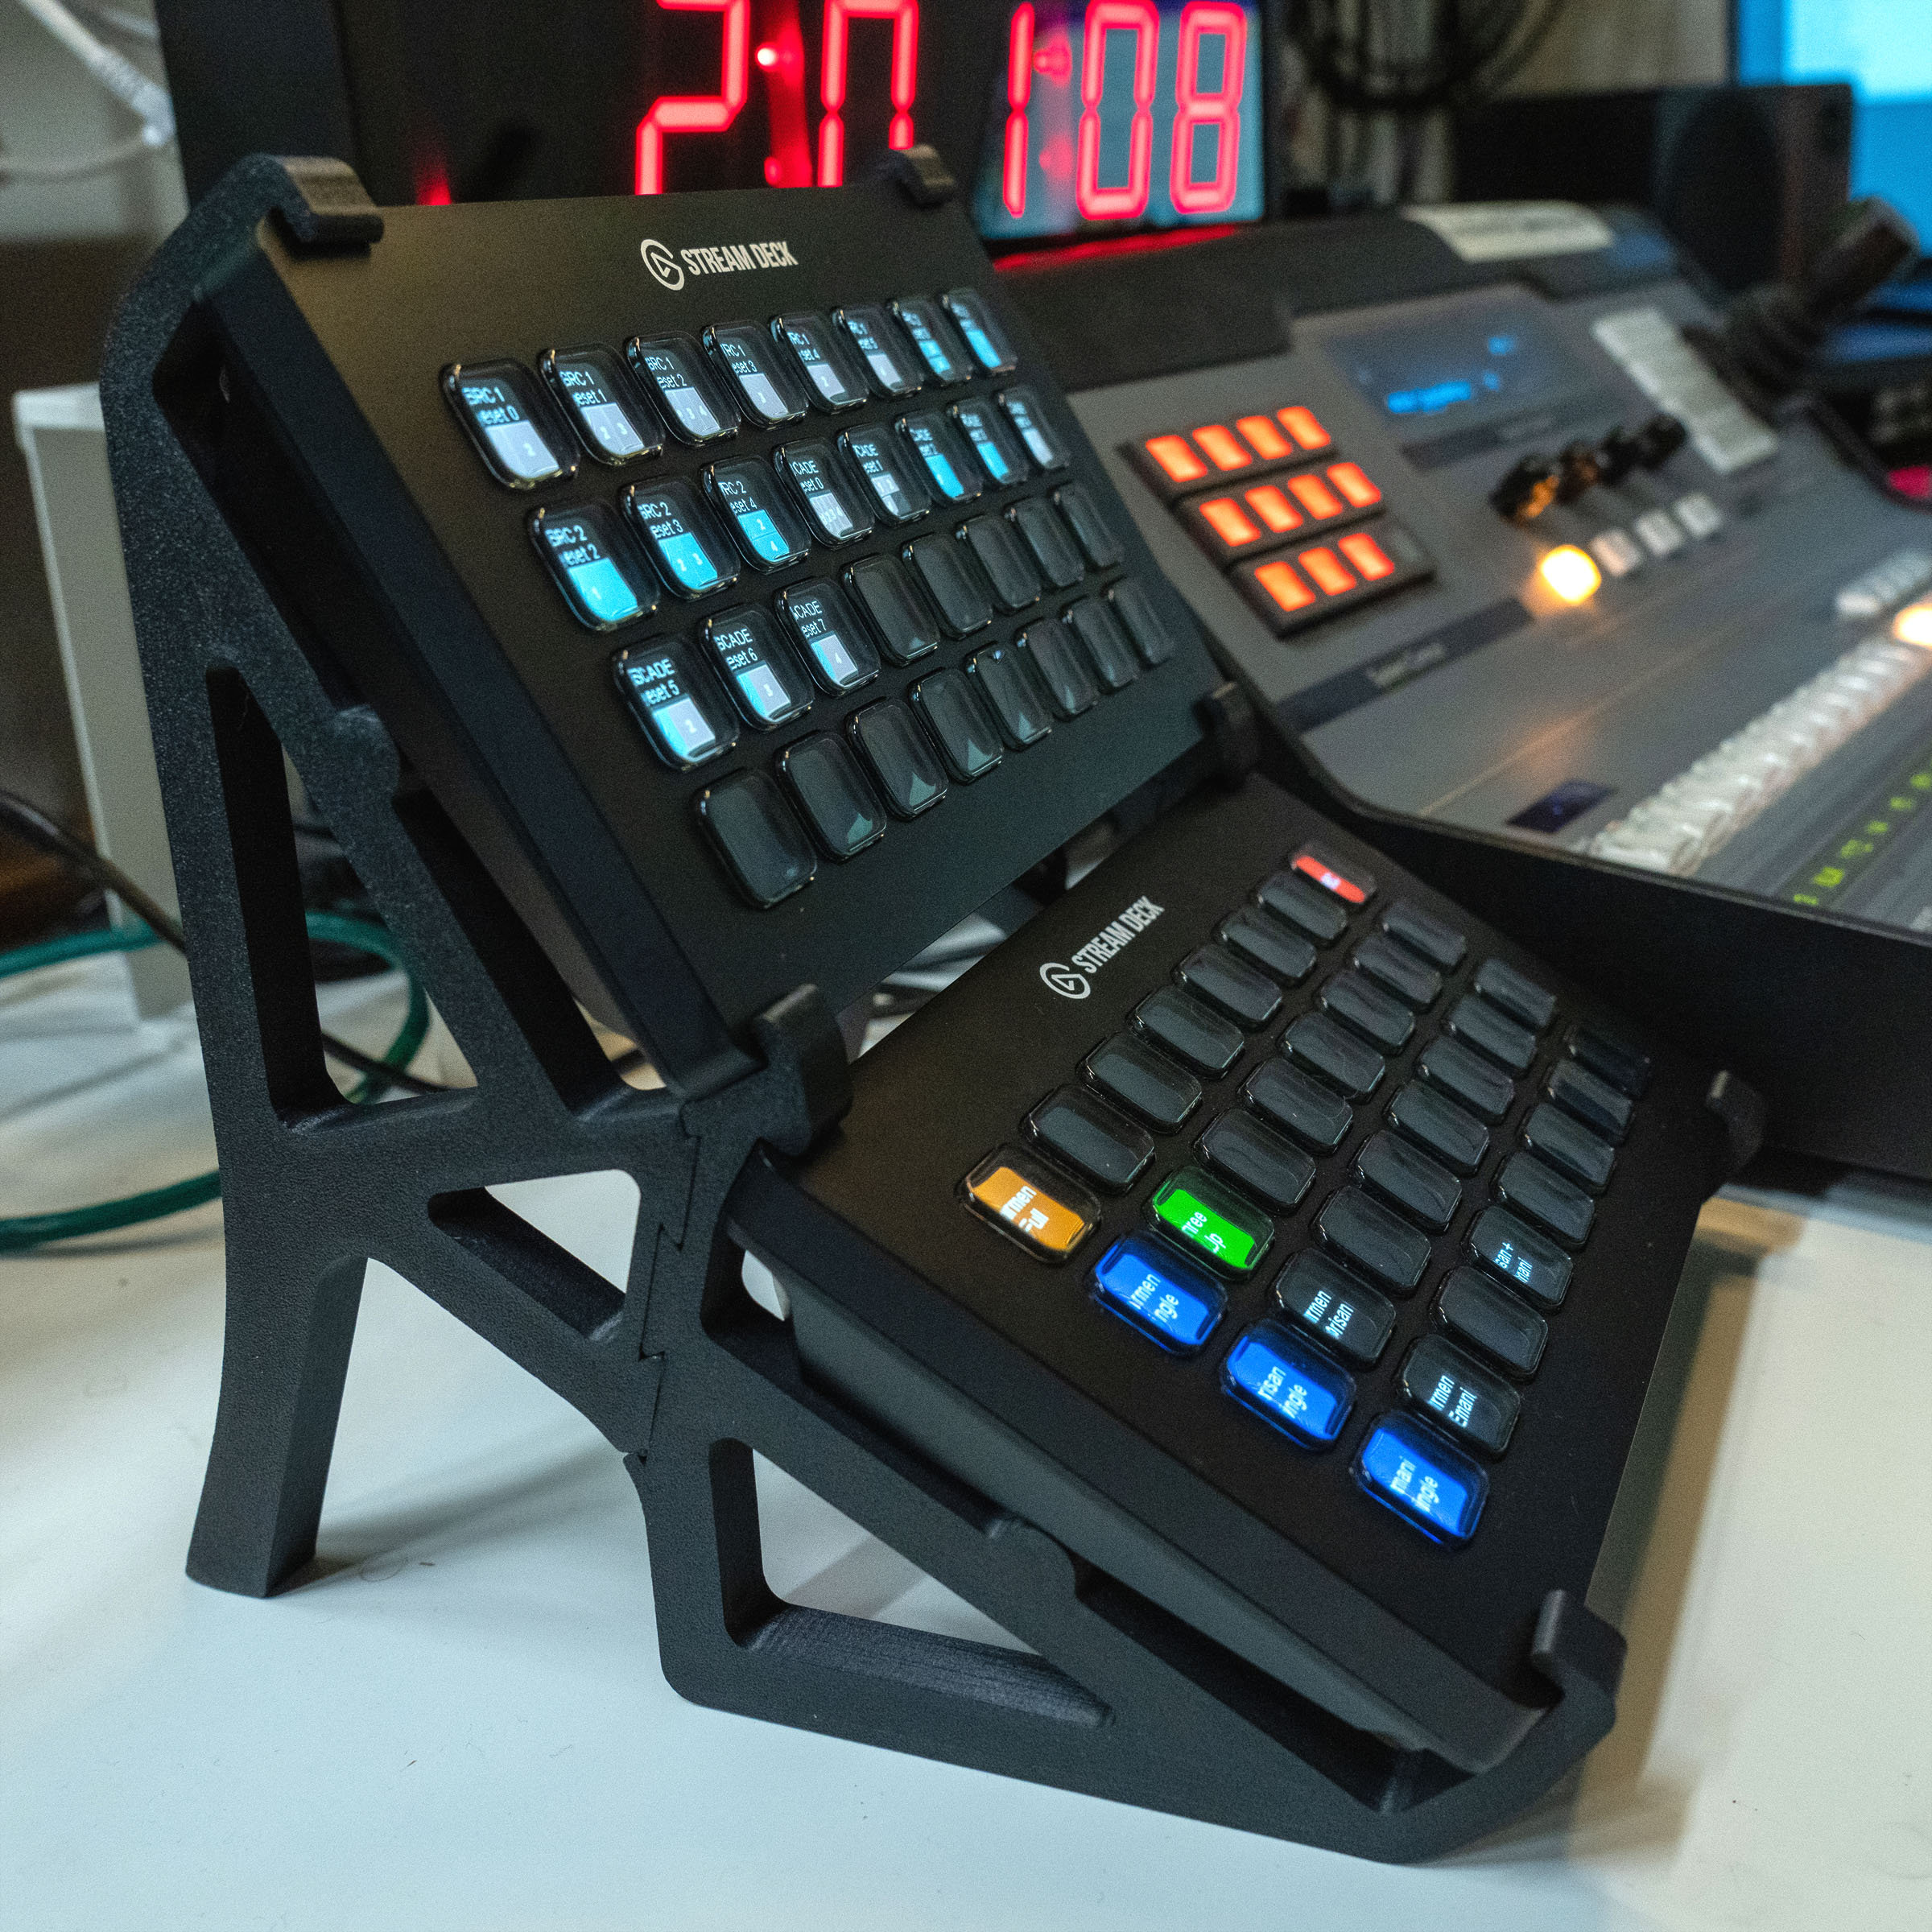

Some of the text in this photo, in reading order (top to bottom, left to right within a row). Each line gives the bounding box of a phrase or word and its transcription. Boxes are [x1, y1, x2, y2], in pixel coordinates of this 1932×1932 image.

[680, 241, 799, 276] STREAM DECK
[737, 345, 746, 357] 1
[666, 357, 675, 369] 1
[748, 360, 758, 372] 3
[584, 371, 595, 385] 1
[676, 374, 687, 386] 2
[493, 386, 506, 402] 1
[597, 388, 607, 402] 1
[506, 405, 520, 421] 0
[852, 444, 879, 458] CADE
[789, 460, 819, 477] CADE
[736, 481, 747, 493] 2
[815, 477, 824, 489] 0
[659, 502, 671, 516] 2
[749, 497, 758, 510] 4
[672, 518, 683, 533] 3
[573, 525, 588, 542] 2
[587, 543, 601, 559] 2
[818, 618, 827, 631] 7
[748, 647, 758, 661] 6
[667, 679, 680, 696] 5
[1071, 895, 1166, 974] STREAM DECK
